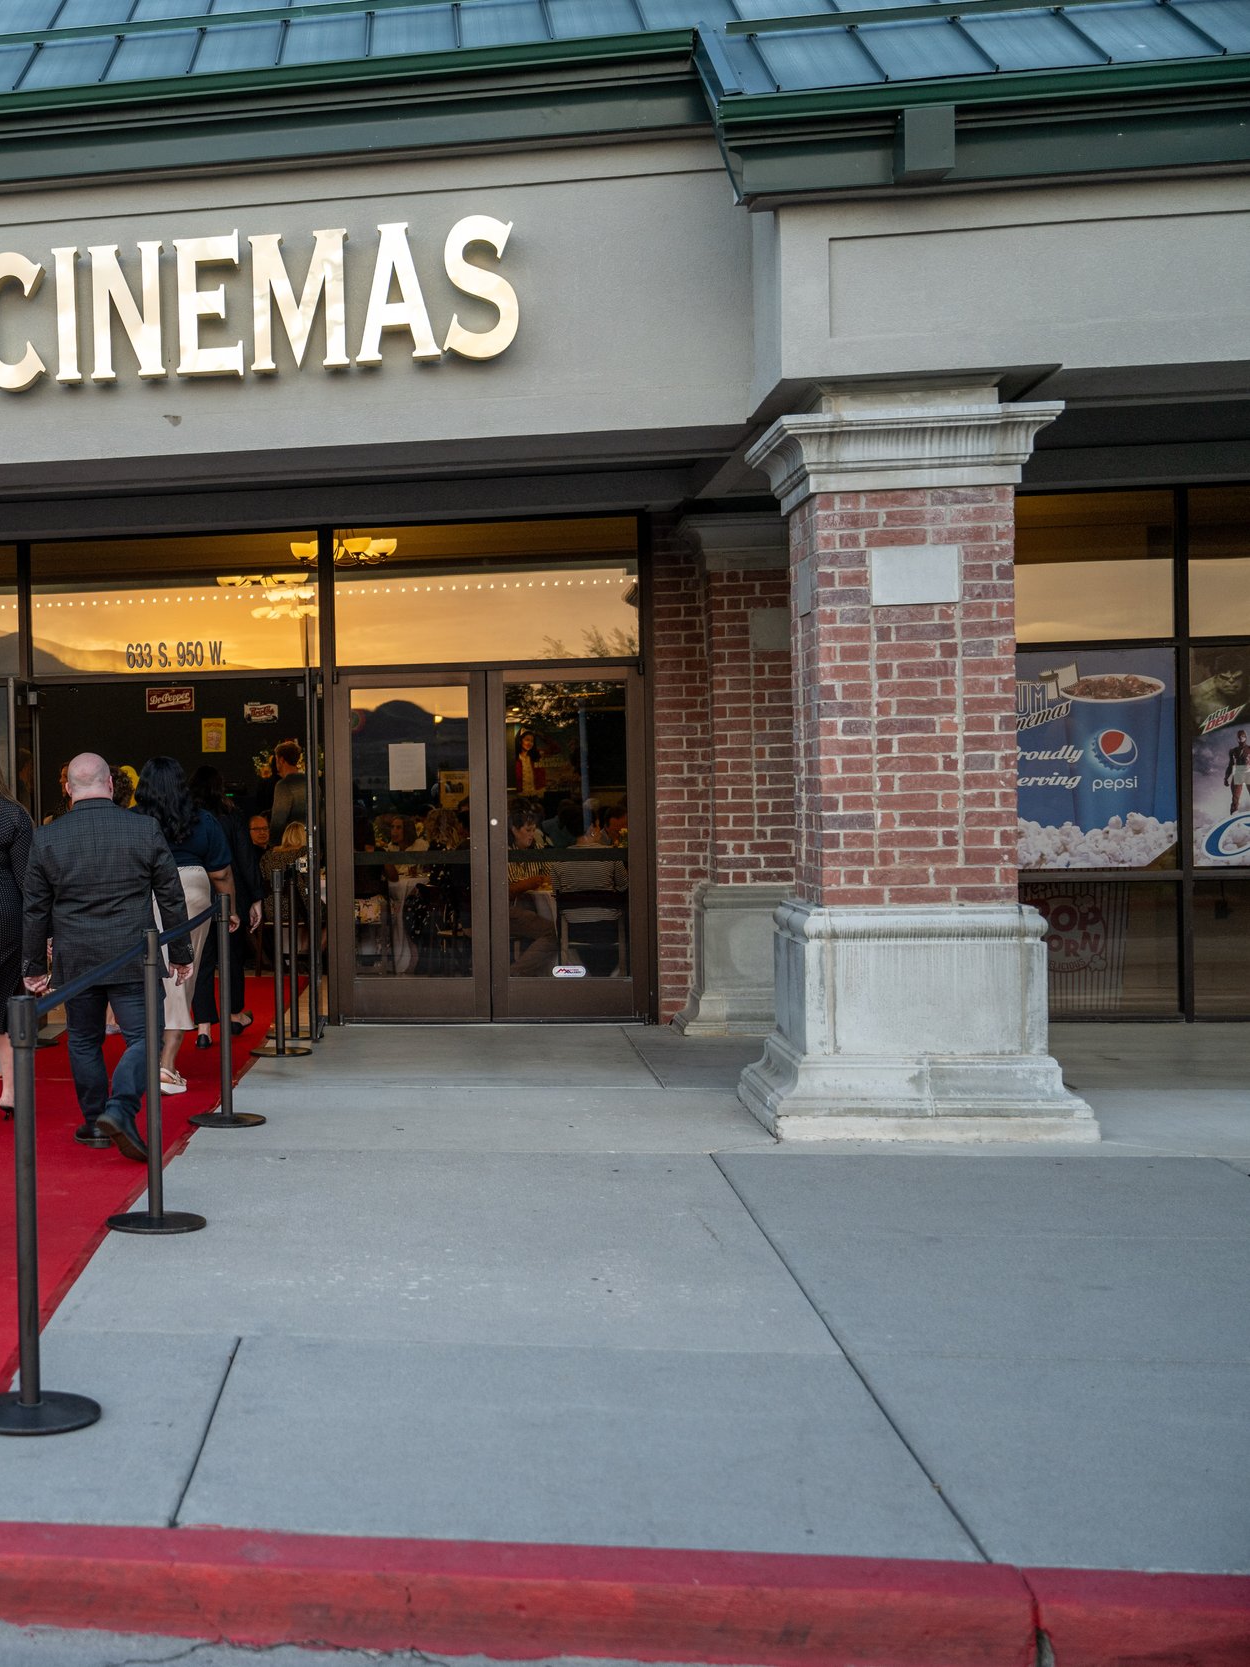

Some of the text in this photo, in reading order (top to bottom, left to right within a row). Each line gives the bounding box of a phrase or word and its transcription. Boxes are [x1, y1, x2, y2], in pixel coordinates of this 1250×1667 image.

[125, 640, 227, 669] 633 S. 950 W.
[1016, 683, 1047, 716] UM
[1016, 701, 1072, 731] nemas
[1017, 772, 1082, 789] erving
[1092, 776, 1138, 792] pepsi
[1046, 931, 1101, 957] ORN
[1049, 958, 1087, 971] ELICIOUS
